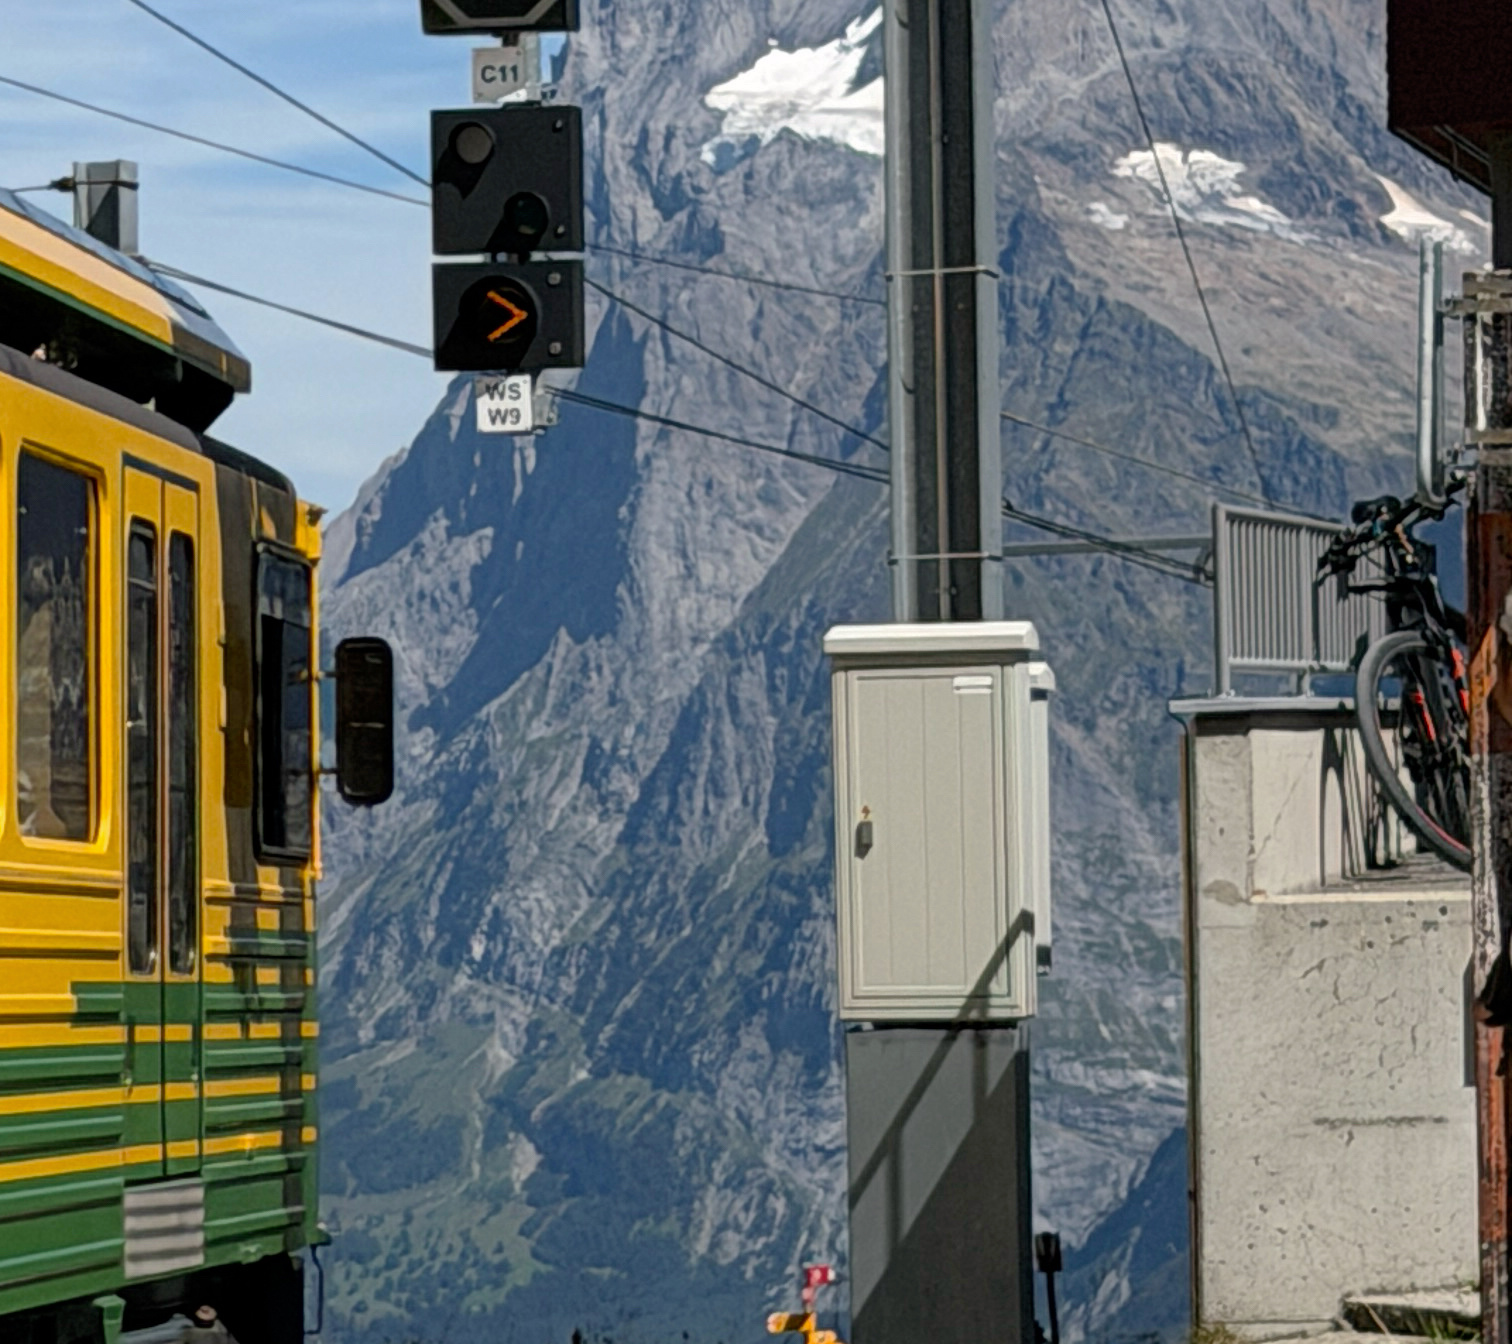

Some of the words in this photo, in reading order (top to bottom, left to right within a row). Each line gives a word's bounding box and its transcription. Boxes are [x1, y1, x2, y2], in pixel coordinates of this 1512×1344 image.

[481, 64, 519, 84] C11
[485, 382, 522, 402] WS
[488, 407, 522, 426] W9
